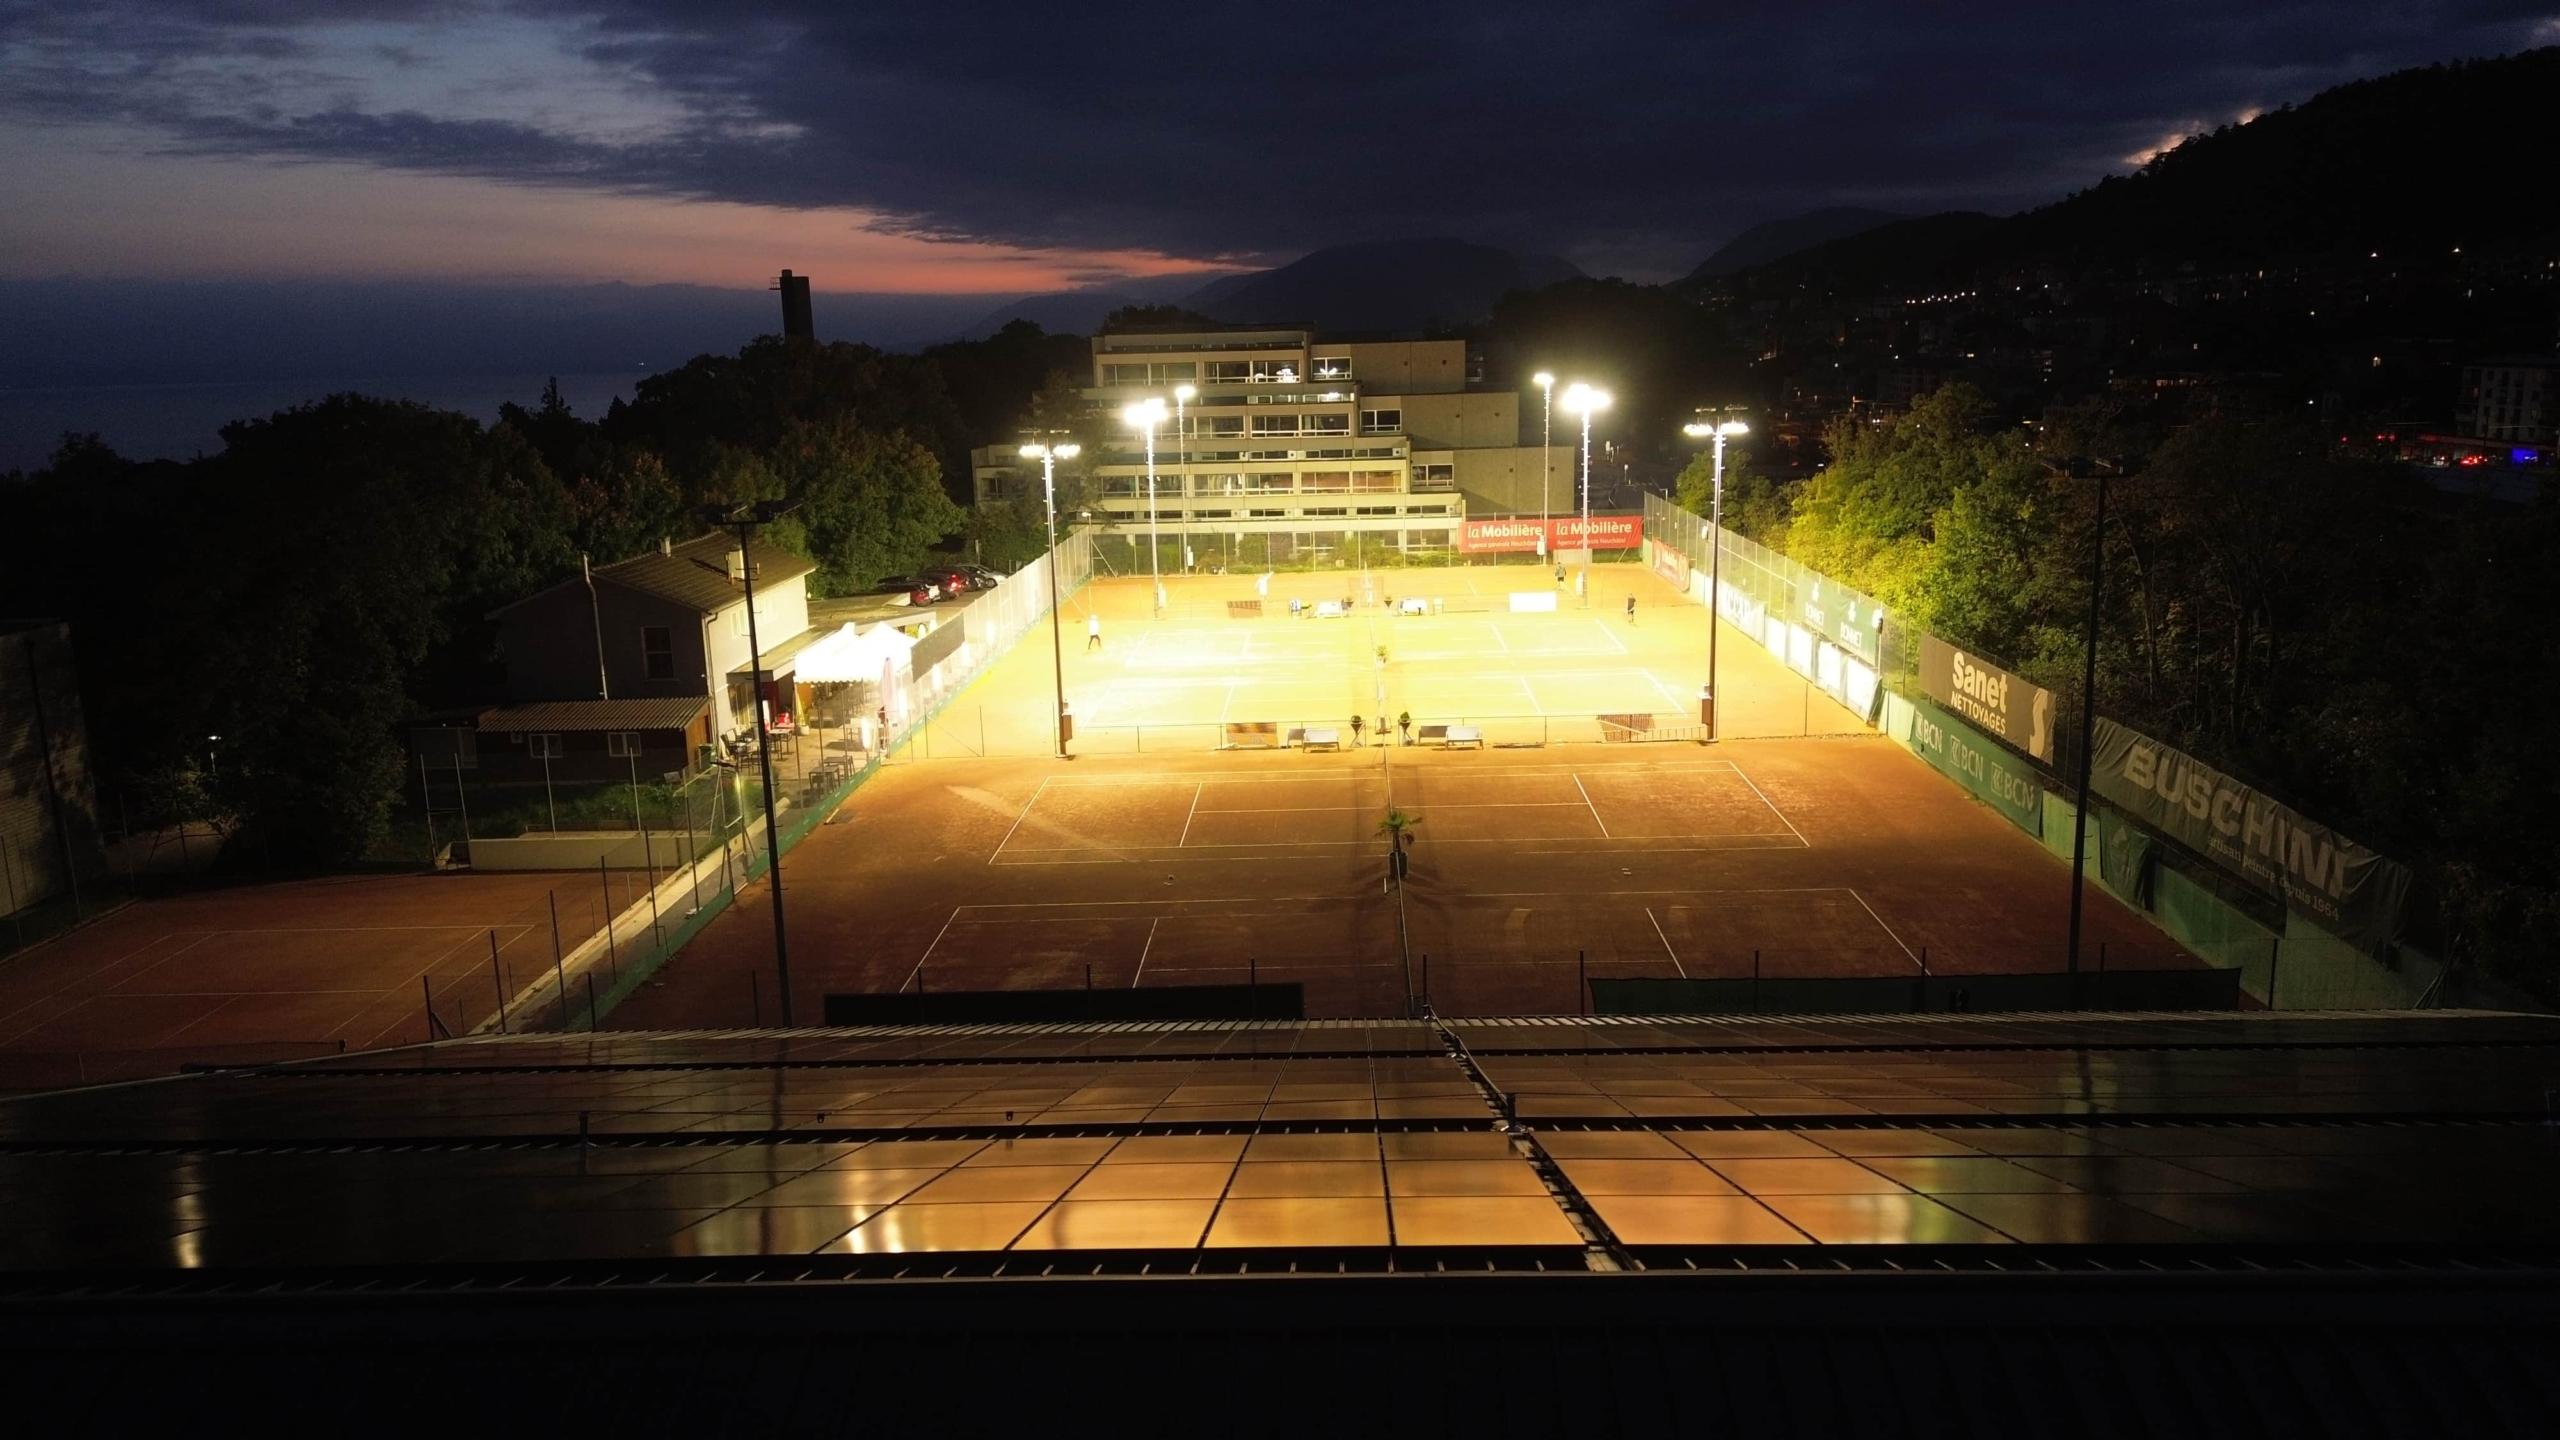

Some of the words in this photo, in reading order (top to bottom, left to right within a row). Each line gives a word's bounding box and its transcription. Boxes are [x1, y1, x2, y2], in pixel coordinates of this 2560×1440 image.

[1468, 525, 1480, 539] la
[1481, 523, 1543, 538] Mobilière
[1556, 522, 1569, 536] la
[1952, 651, 2008, 714] Sanet
[1950, 692, 2007, 736] NETTOYAGES
[1922, 719, 1943, 755] BCN
[1961, 745, 1985, 783] BCN
[2004, 770, 2036, 812] BCN
